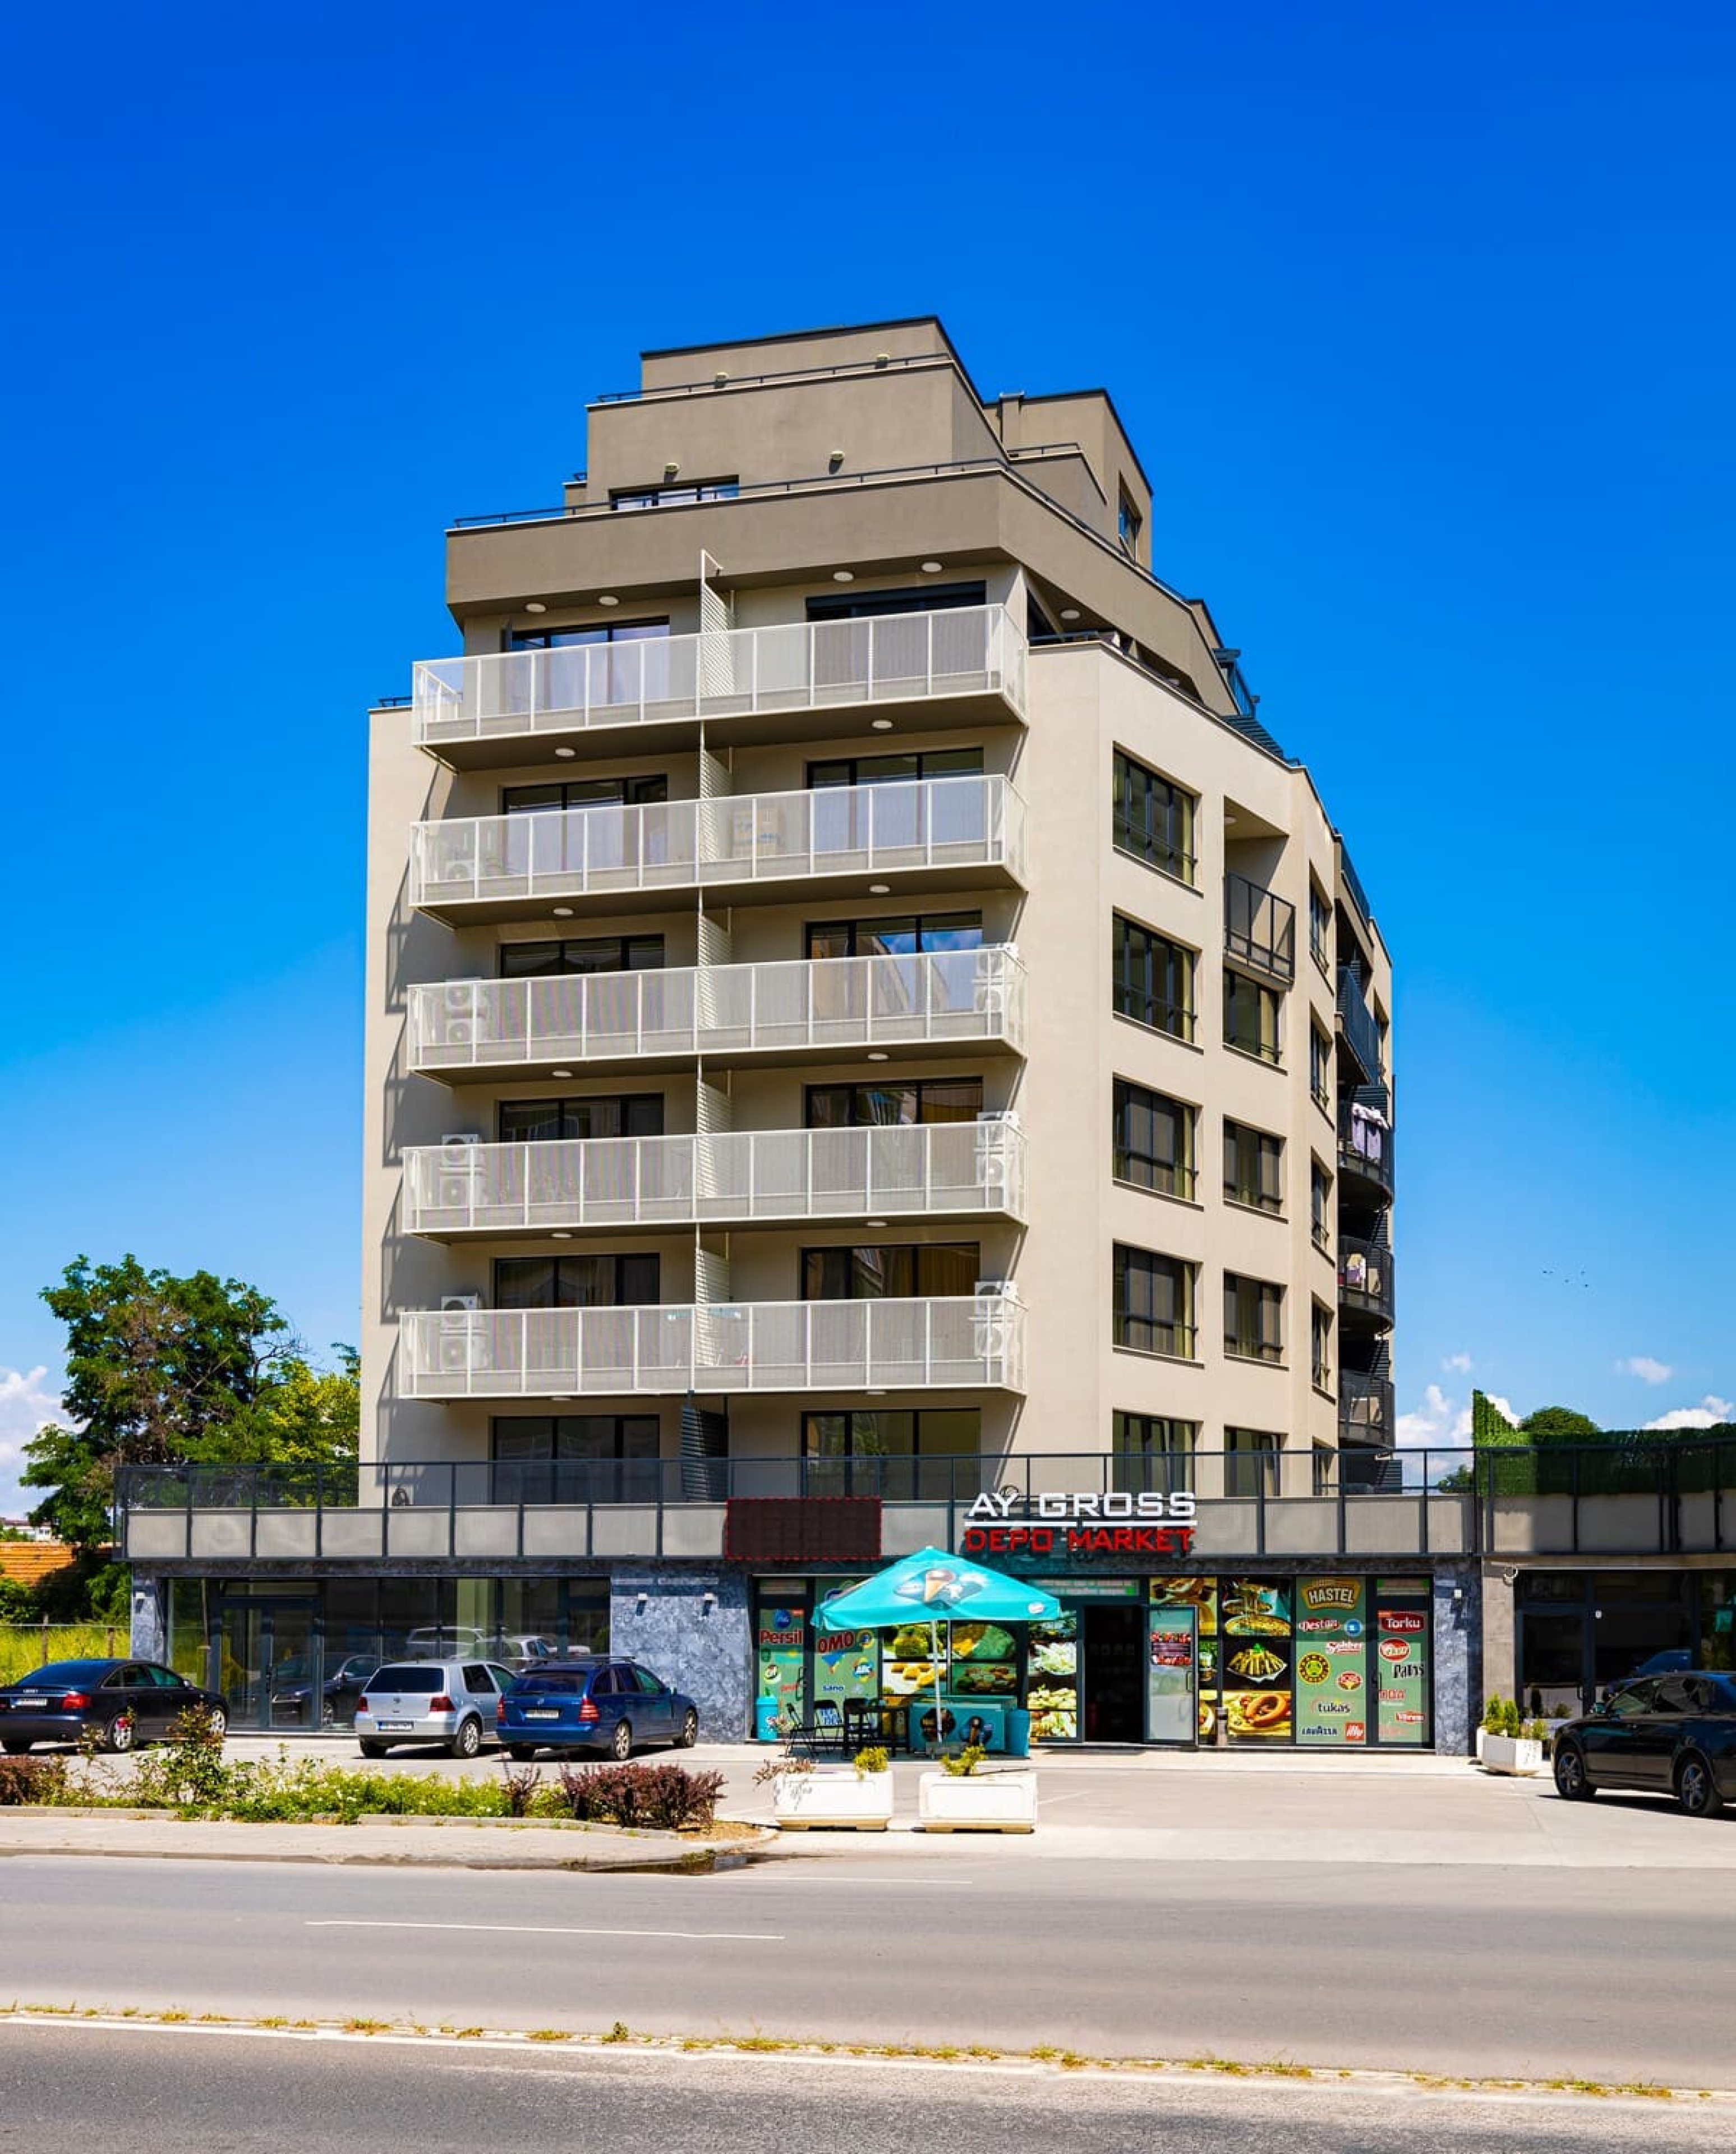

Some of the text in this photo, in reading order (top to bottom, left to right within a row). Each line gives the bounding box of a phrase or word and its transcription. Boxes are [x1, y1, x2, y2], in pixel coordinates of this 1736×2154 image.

[969, 1493, 1195, 1516] AY GROSS
[965, 1528, 1195, 1552] DEPO MARKET
[1309, 1588, 1353, 1604] HASTEL
[1385, 1617, 1420, 1628] Torku
[759, 1630, 803, 1644] Persil
[818, 1631, 854, 1653] OMO
